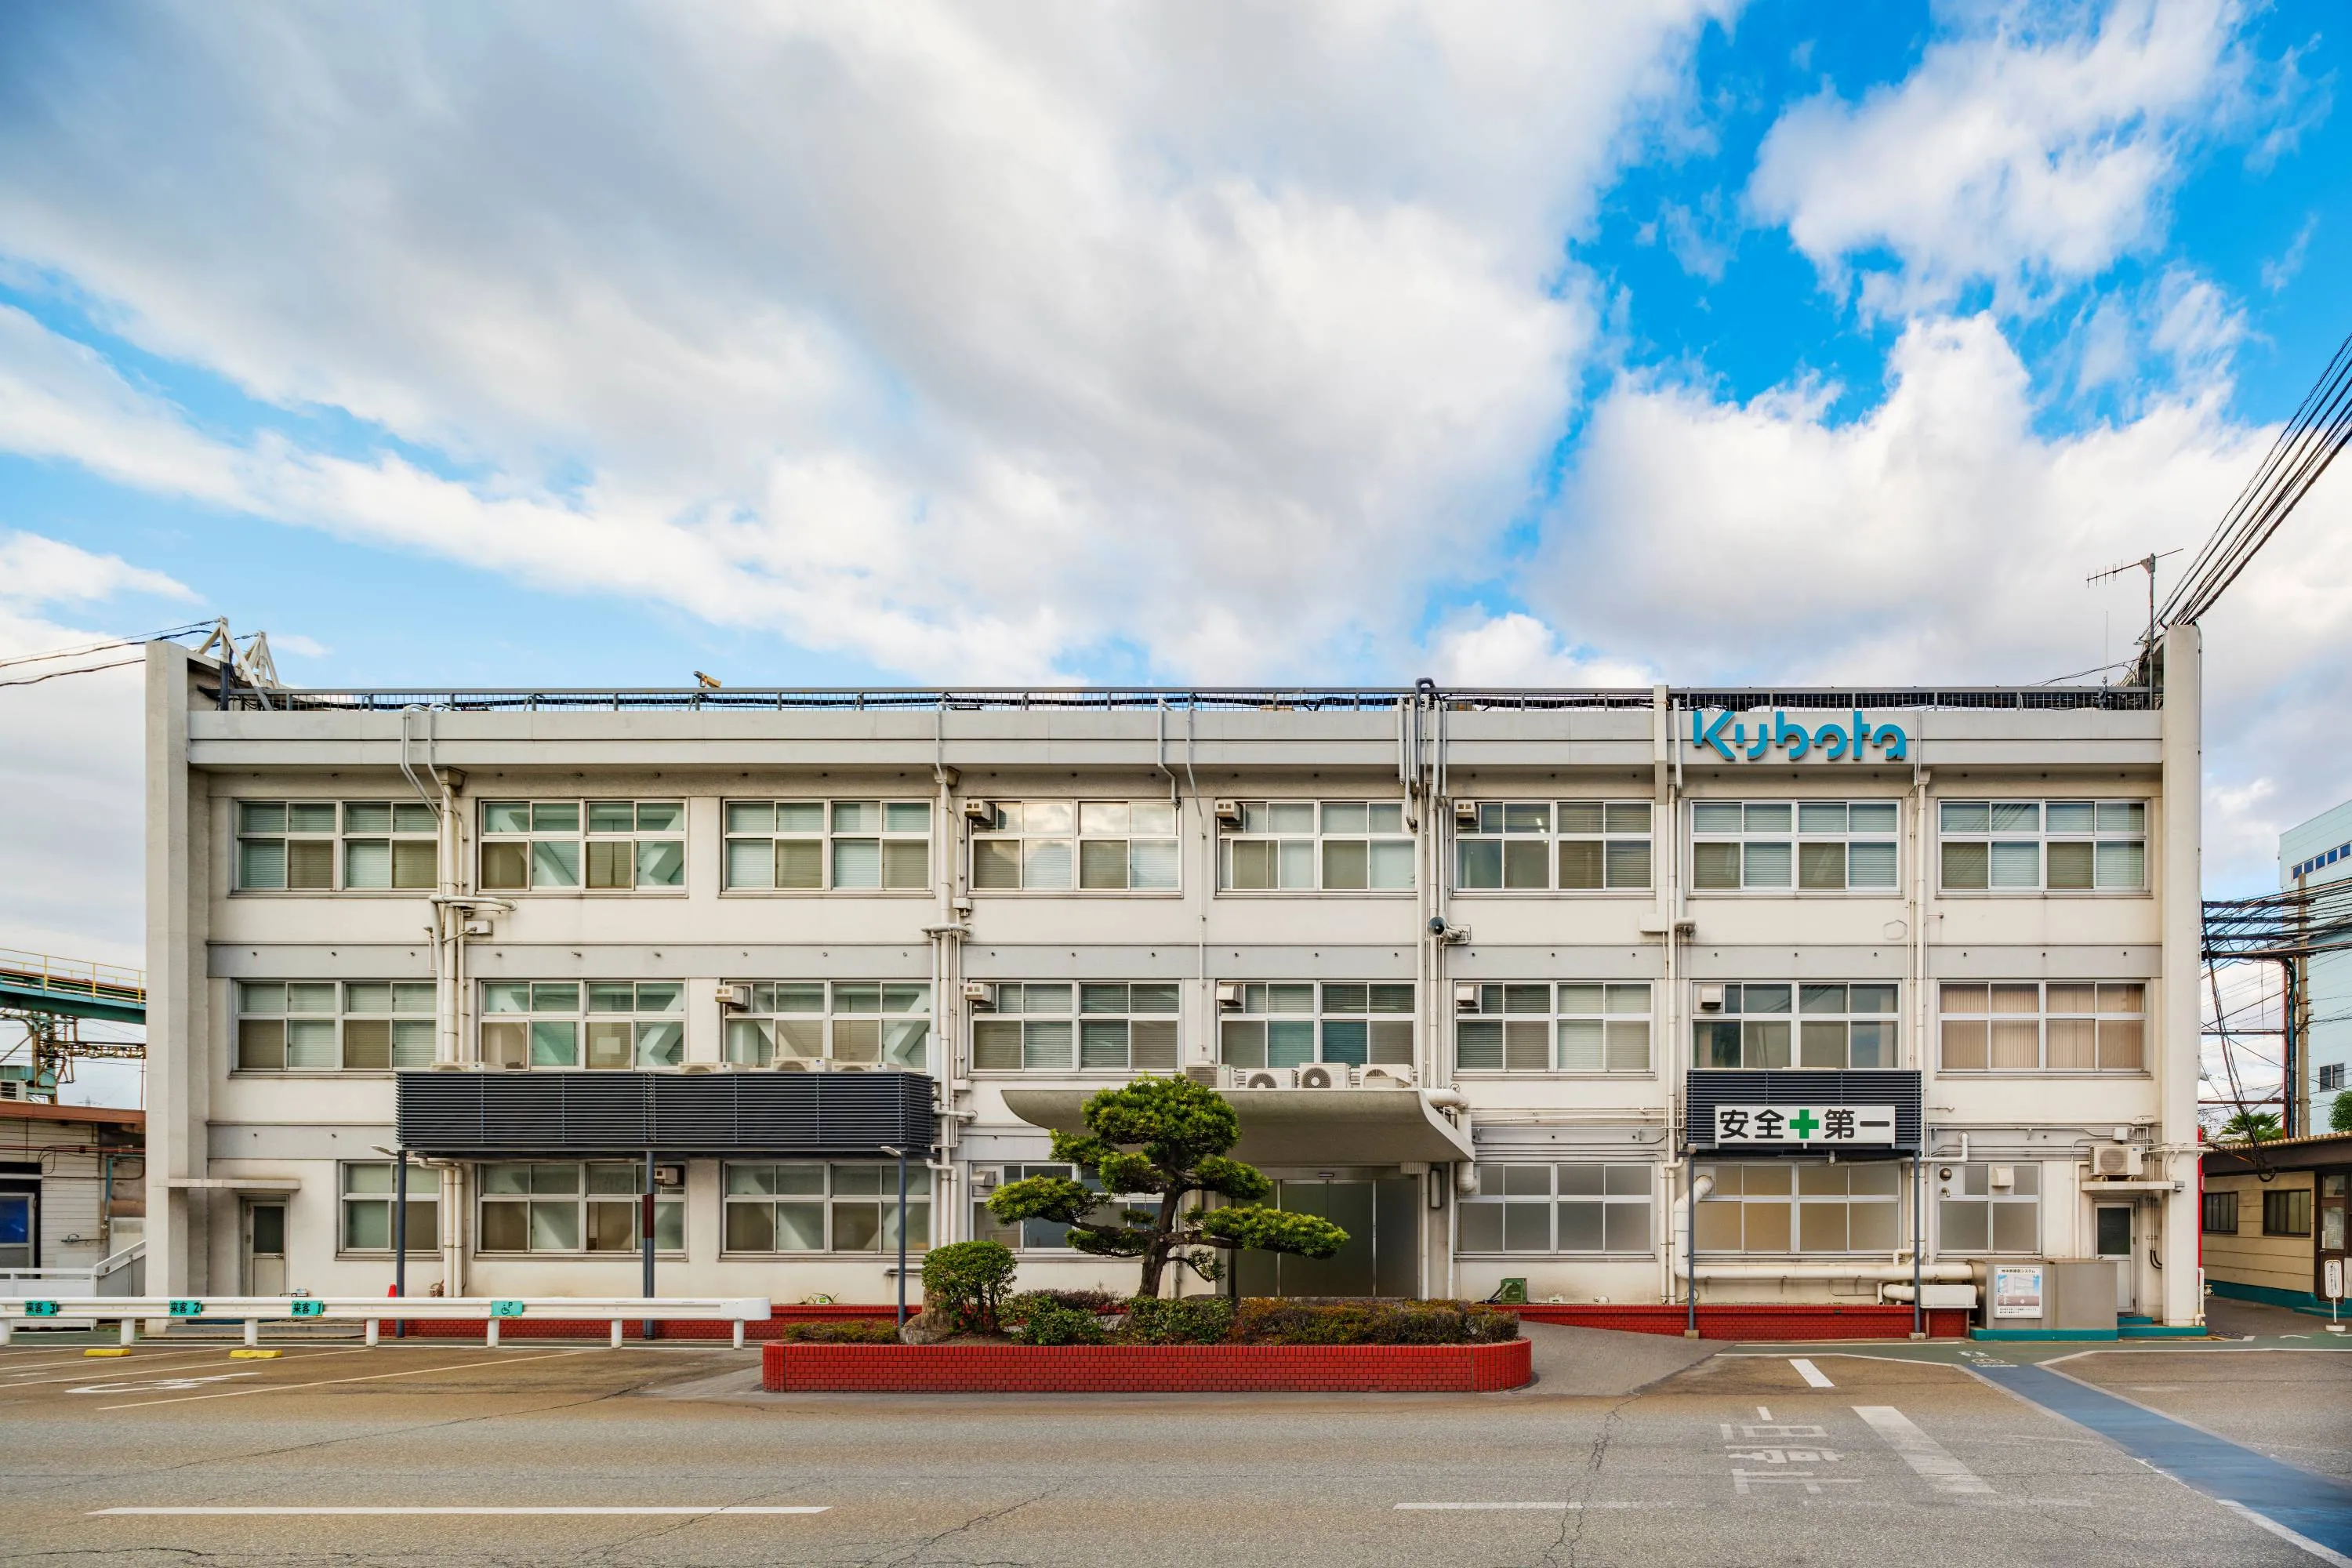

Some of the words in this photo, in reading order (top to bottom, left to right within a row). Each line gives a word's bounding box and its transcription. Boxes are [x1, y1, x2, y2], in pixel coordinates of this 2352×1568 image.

[1693, 711, 1907, 760] Kubota
[1719, 1109, 1784, 1139] 安全
[1824, 1109, 1890, 1139] 第一
[26, 1302, 43, 1314] 来客
[50, 1303, 56, 1314] 3
[170, 1302, 187, 1313] 来客
[194, 1302, 200, 1313] 2
[293, 1302, 310, 1314] 来客
[318, 1303, 321, 1314] 1
